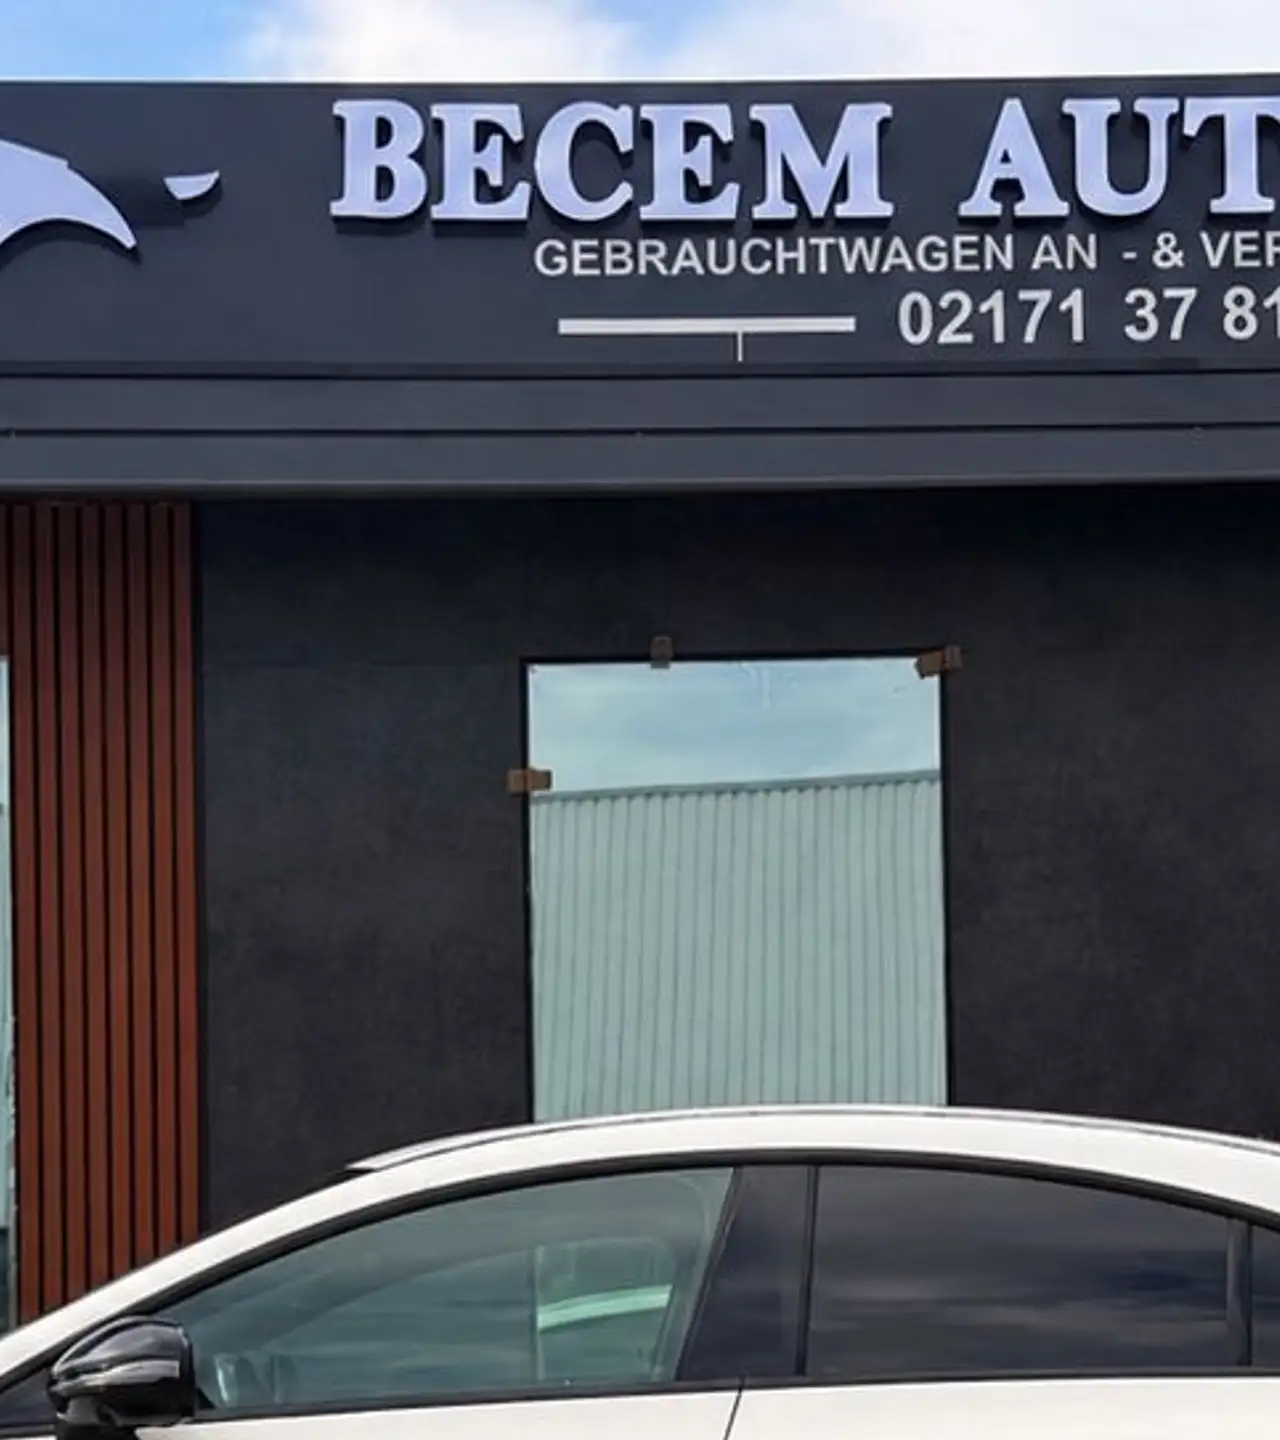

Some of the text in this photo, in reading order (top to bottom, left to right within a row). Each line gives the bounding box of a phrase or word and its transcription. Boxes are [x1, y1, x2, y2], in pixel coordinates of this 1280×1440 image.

[329, 99, 894, 221] BECEM
[534, 233, 1014, 277] GEBRAUCHTWAGEN
[1031, 233, 1097, 270] AN
[1152, 232, 1185, 269] &
[899, 288, 1084, 345] 02171
[1124, 287, 1198, 342] 37
